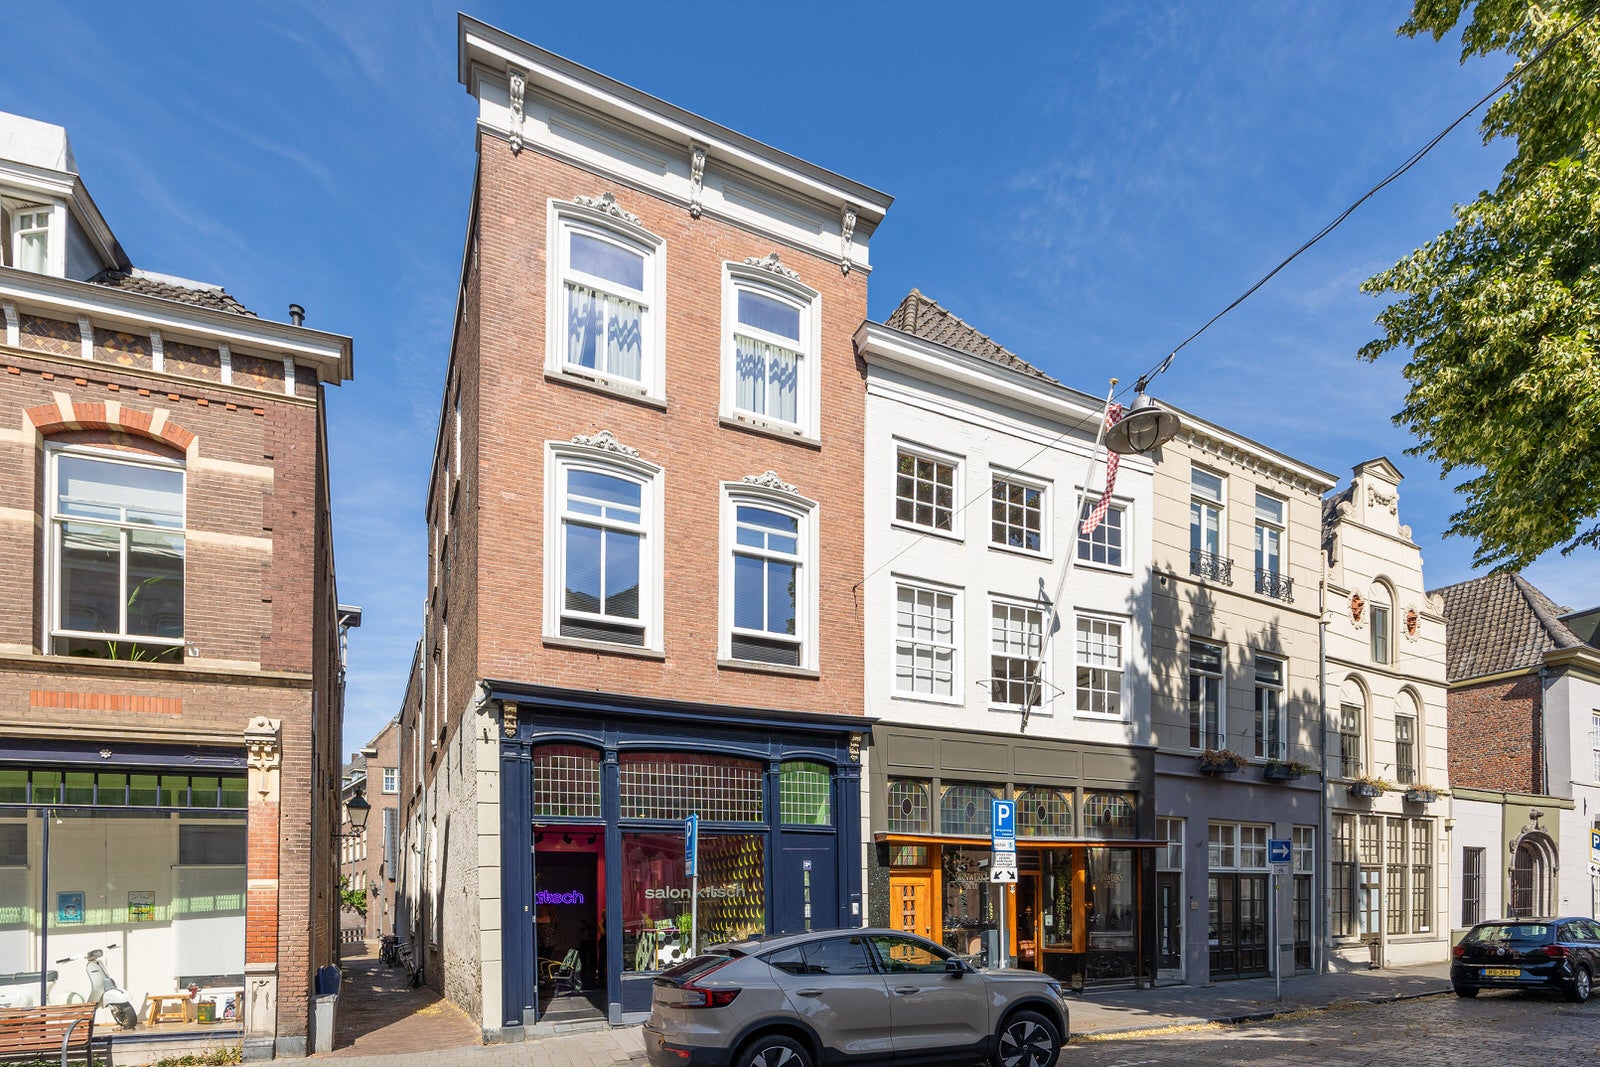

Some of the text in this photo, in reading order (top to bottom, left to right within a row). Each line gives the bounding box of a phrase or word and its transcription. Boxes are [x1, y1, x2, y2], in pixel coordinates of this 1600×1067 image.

[998, 804, 1010, 826] P
[686, 821, 692, 846] P
[1593, 834, 1600, 848] P
[644, 885, 691, 899] salon
